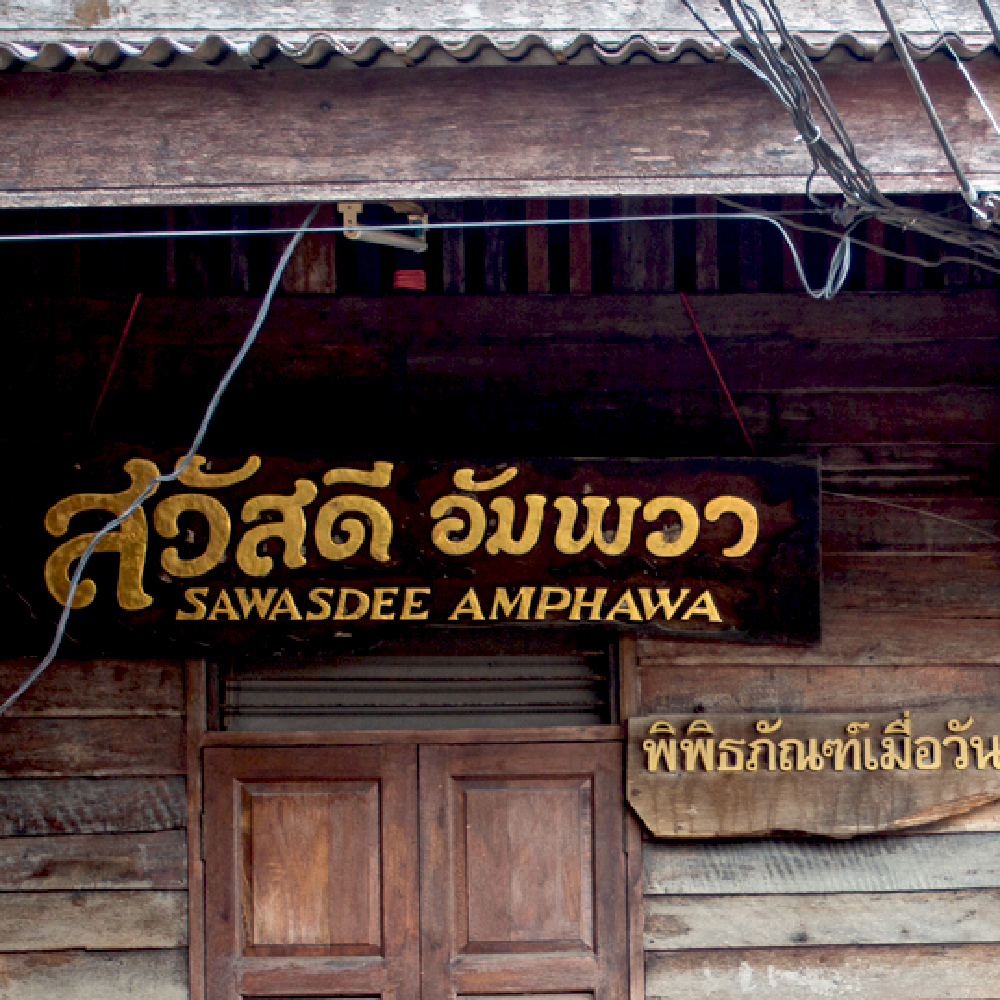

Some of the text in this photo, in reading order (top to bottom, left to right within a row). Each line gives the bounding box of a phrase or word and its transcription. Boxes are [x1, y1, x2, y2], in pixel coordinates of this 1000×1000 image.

[44, 455, 759, 610] สวัสดี อัมพวา
[175, 586, 723, 623] SAWASDEE AMPHAWA
